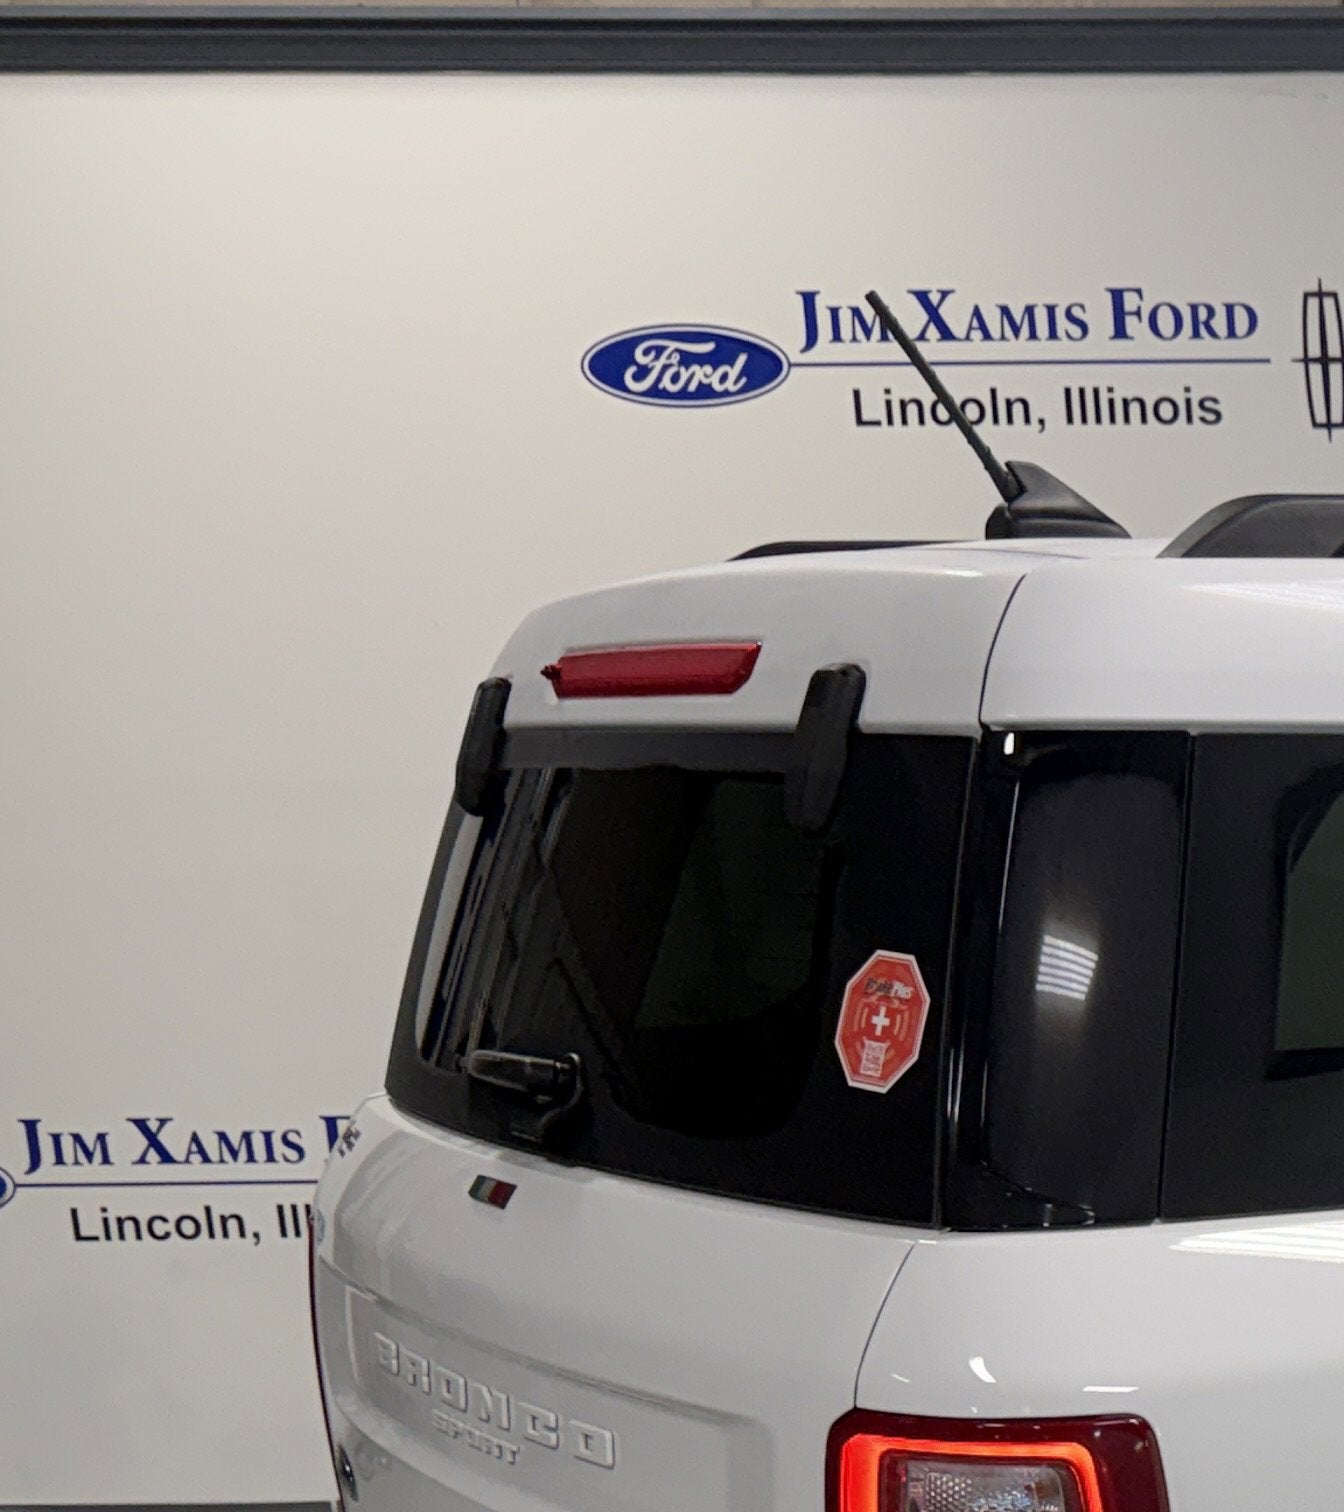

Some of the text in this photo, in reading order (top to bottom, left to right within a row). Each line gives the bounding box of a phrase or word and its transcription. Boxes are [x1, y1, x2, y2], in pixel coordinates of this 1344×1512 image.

[795, 287, 1259, 353] JIM XAMIS FORD
[623, 339, 748, 393] Ford
[1063, 386, 1223, 425] Illinois
[17, 1118, 114, 1175] JIM
[127, 1117, 306, 1165] XAMIS
[70, 1204, 261, 1246] Lincoln,
[373, 1331, 616, 1470] BRONCO
[432, 1408, 521, 1465] SPORT
